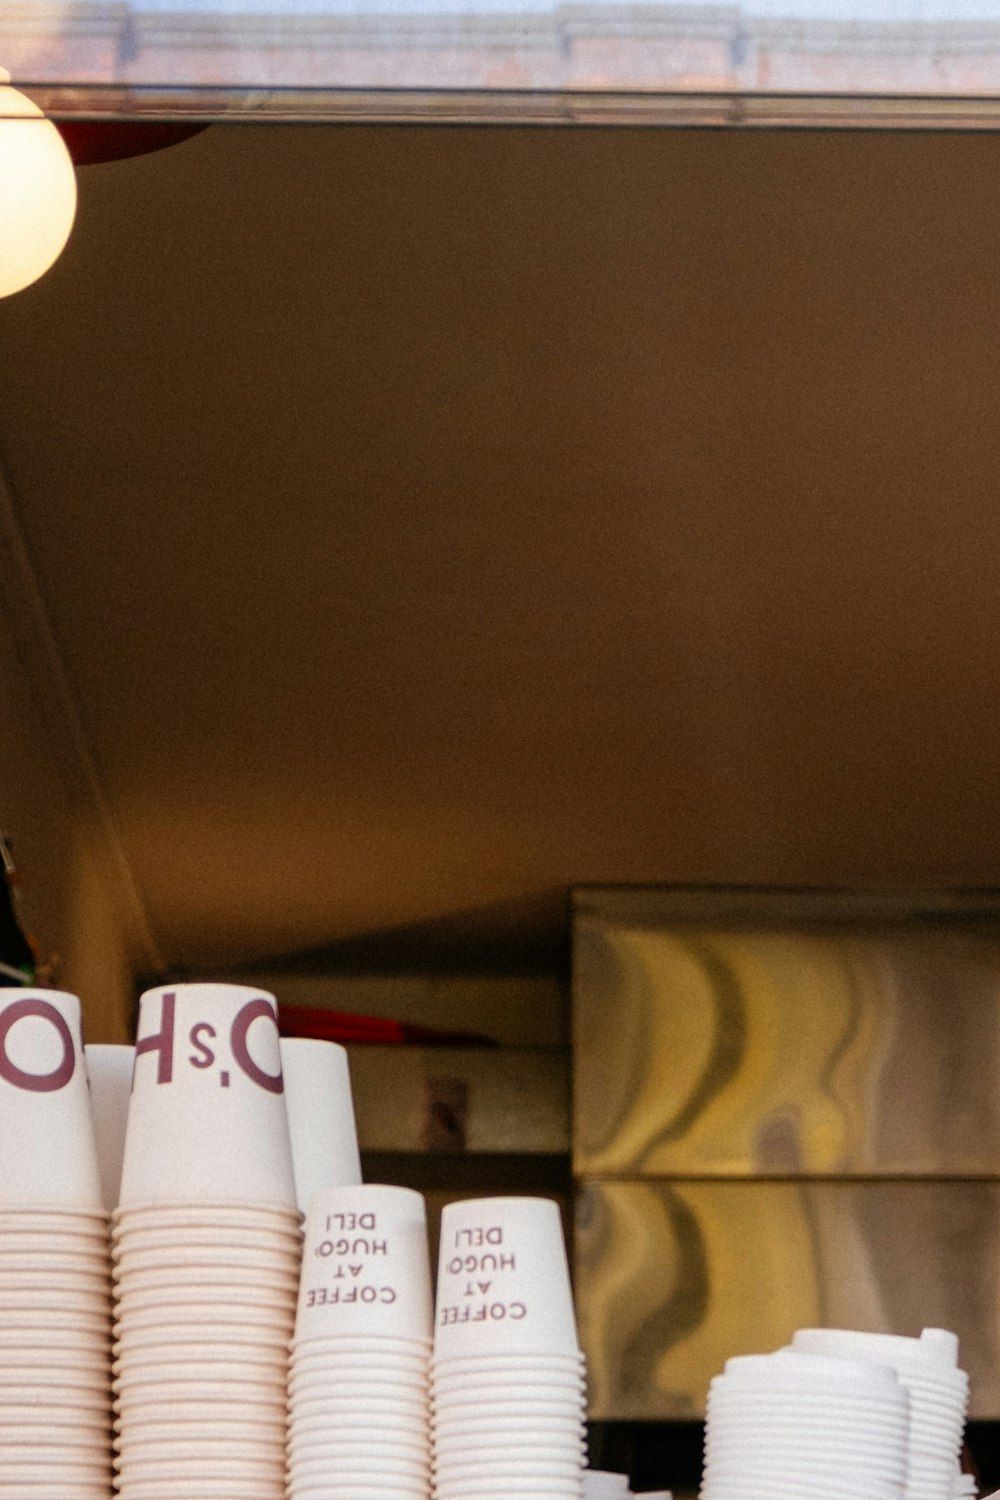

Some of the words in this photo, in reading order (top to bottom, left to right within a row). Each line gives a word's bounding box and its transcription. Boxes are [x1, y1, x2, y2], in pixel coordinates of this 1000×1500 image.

[326, 1213, 375, 1231] DELI
[455, 1227, 502, 1248] DELI
[333, 1264, 363, 1278] AT
[305, 1285, 396, 1308] COFFEE
[464, 1280, 492, 1296] AT
[441, 1302, 527, 1326] COFFEE
